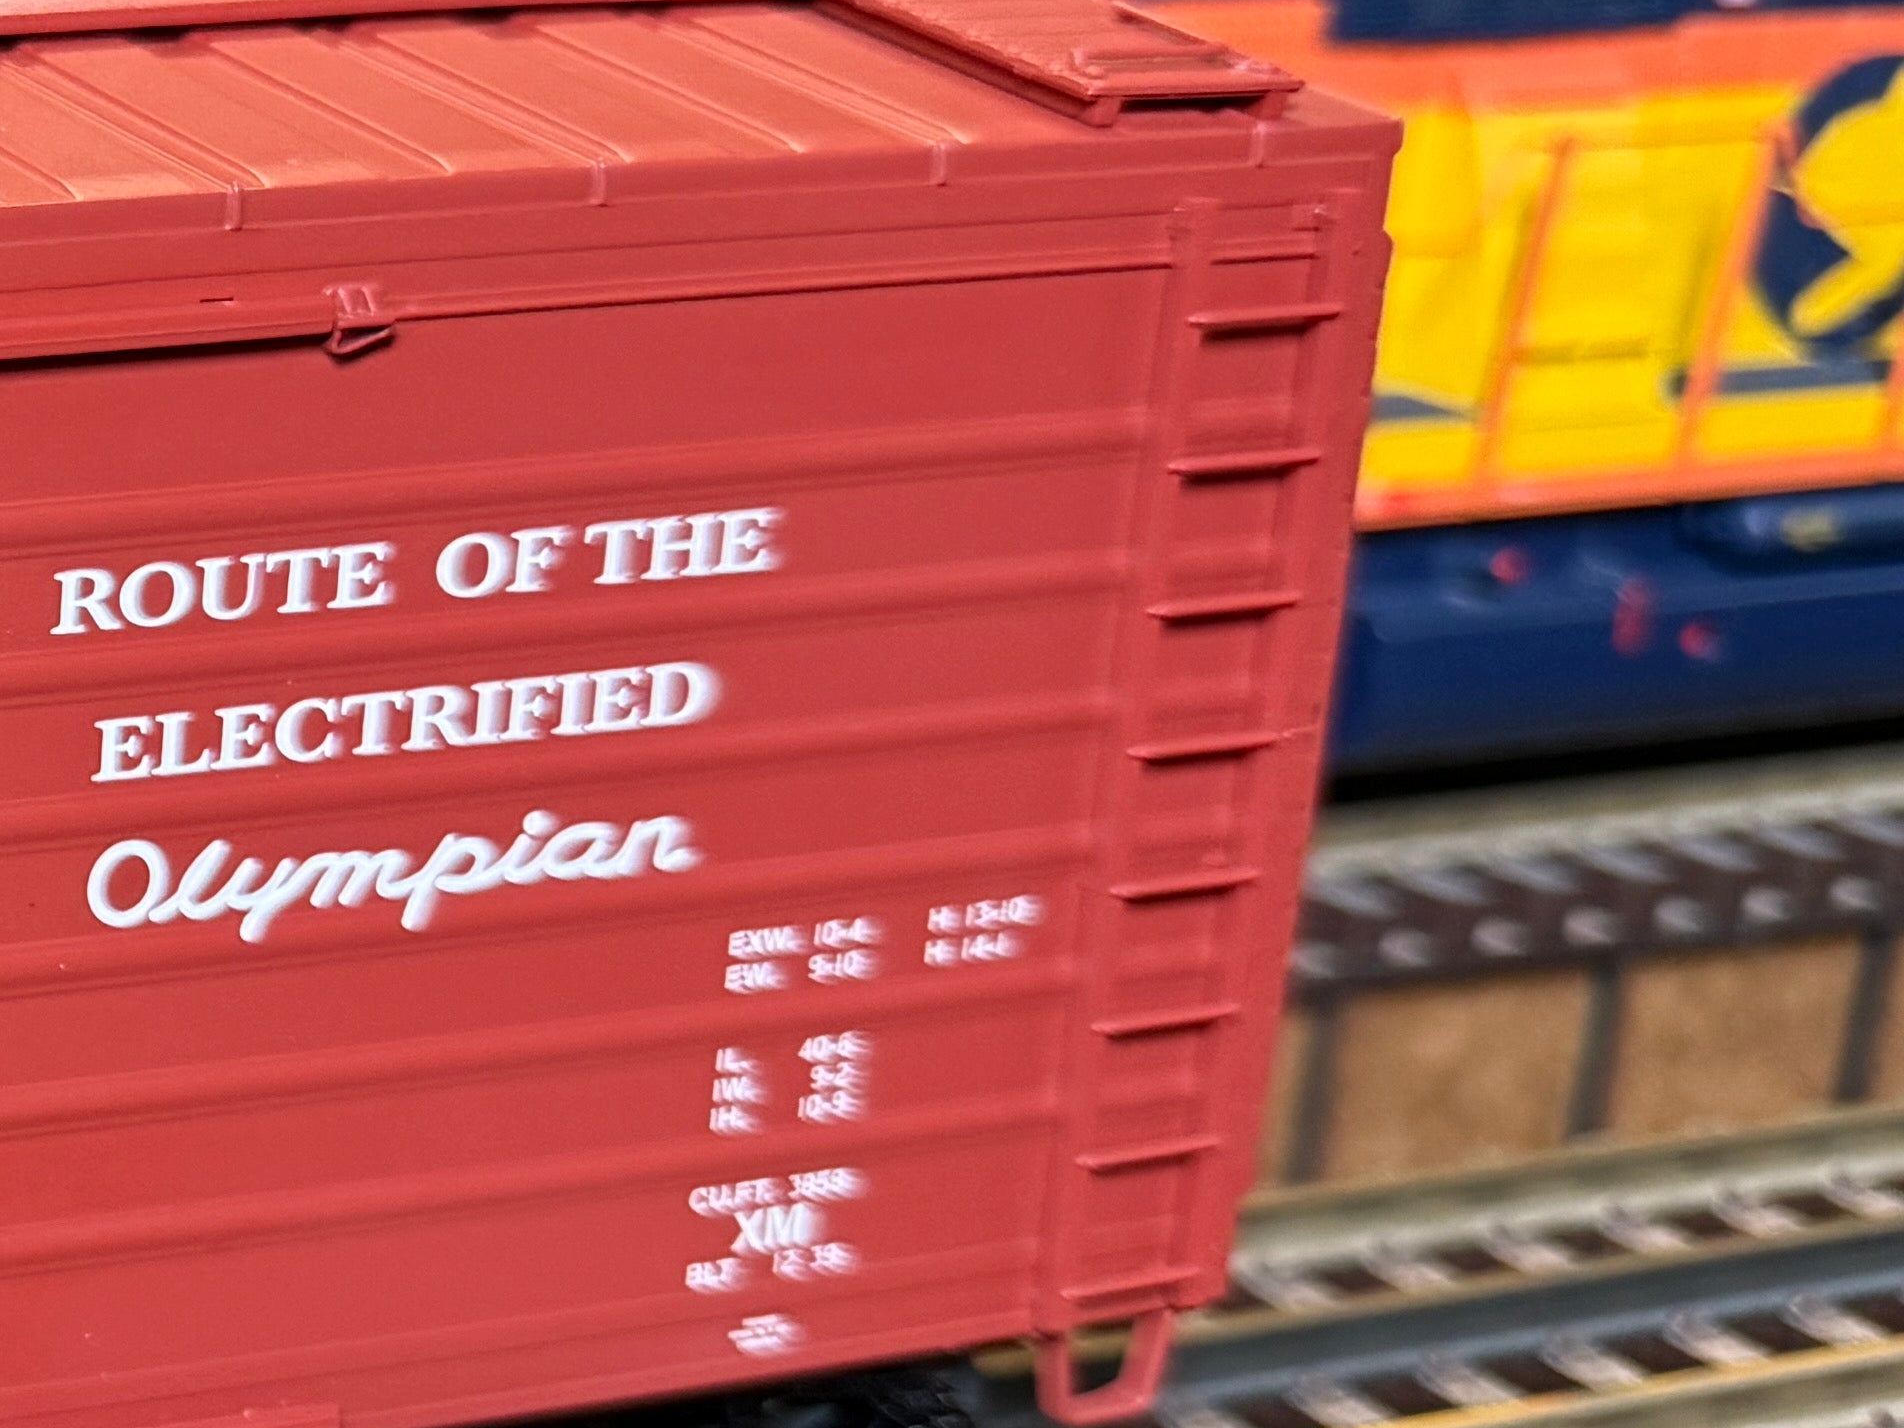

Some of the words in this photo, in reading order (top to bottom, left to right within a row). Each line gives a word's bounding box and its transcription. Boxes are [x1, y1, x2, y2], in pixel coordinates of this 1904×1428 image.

[50, 542, 395, 635] ROUTE
[435, 525, 574, 599] OF
[584, 506, 783, 585] THE
[90, 661, 720, 783] ELECTRIFIED
[86, 809, 700, 943] Olympian
[731, 1201, 828, 1256] XM
